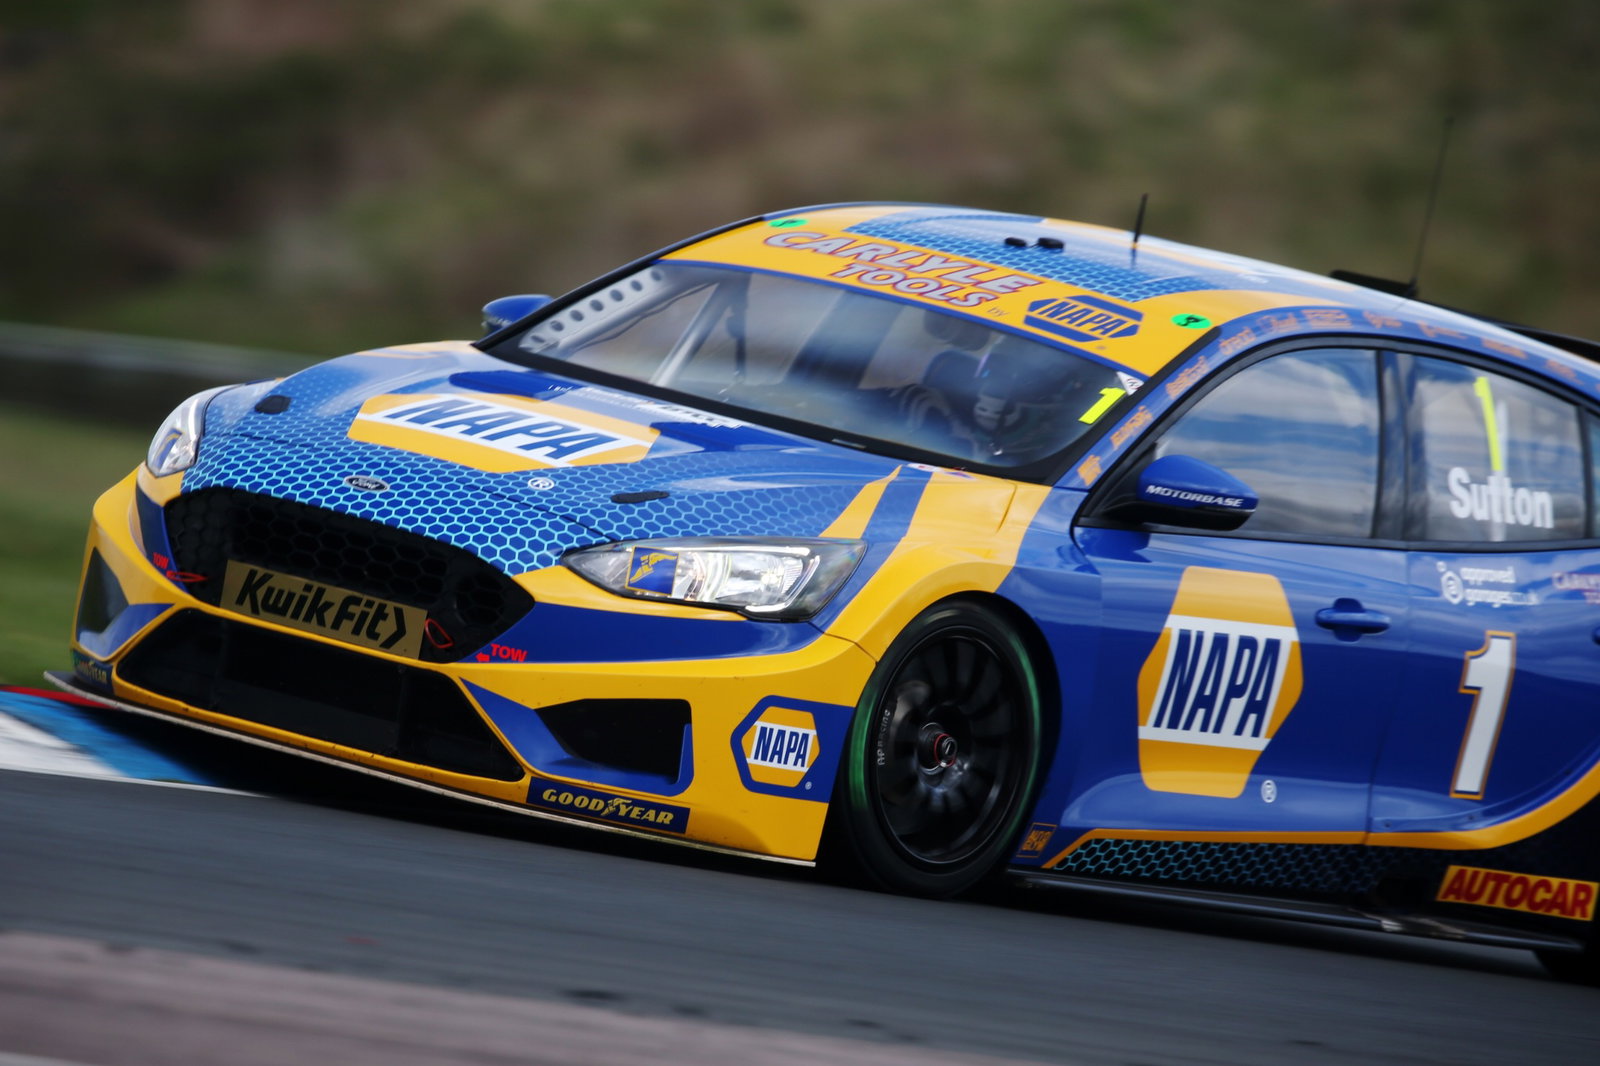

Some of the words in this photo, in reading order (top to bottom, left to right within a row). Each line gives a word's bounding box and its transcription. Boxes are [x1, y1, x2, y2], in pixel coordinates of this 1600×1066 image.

[764, 231, 1044, 294] CARLYLE
[829, 262, 999, 309] TOOLS
[1038, 299, 1128, 339] NAPA
[385, 398, 622, 460] NAPA
[1078, 387, 1127, 425] 1
[1145, 484, 1244, 509] MOTORBASE
[1447, 466, 1555, 530] Sutton
[152, 552, 169, 570] TOW
[489, 643, 528, 663] TOW
[1152, 628, 1282, 739] NAPA
[1450, 630, 1516, 801] 1
[753, 725, 811, 768] NAPA
[1439, 869, 1597, 918] AUTOCAR
